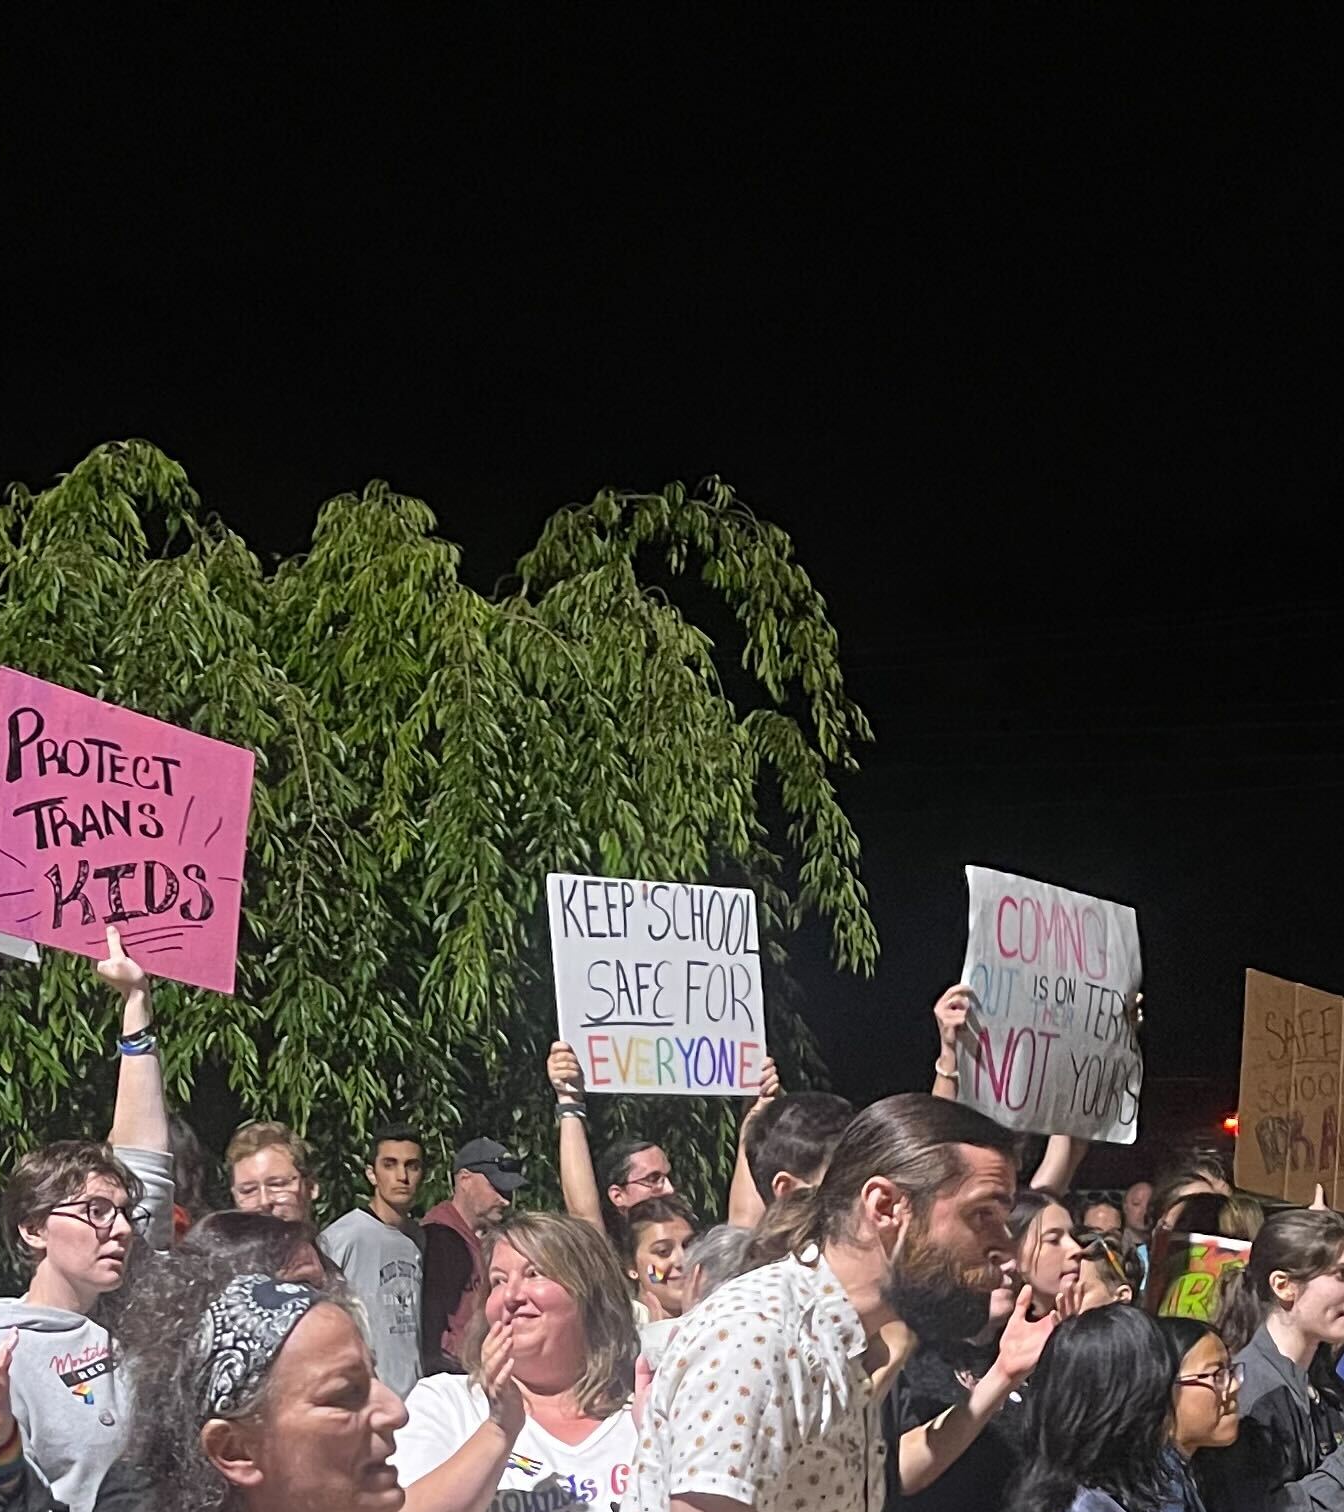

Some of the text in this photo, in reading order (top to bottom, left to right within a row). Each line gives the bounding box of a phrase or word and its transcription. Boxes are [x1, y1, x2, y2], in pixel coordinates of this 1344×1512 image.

[6, 706, 181, 797] PROTECT
[13, 796, 164, 850] TRANS
[44, 859, 215, 929] KIDS
[559, 879, 635, 938] KEEP
[997, 895, 1107, 980] COMING
[585, 959, 754, 1032] SAFE FOR
[971, 962, 1019, 1018] OUT
[1033, 976, 1048, 1001] IS
[1055, 976, 1077, 1006] ON
[588, 1035, 762, 1089] EVERYONE
[1265, 1007, 1339, 1061] SAFE
[974, 1027, 1141, 1126] NOT YOURS
[77, 1362, 105, 1380] RED
